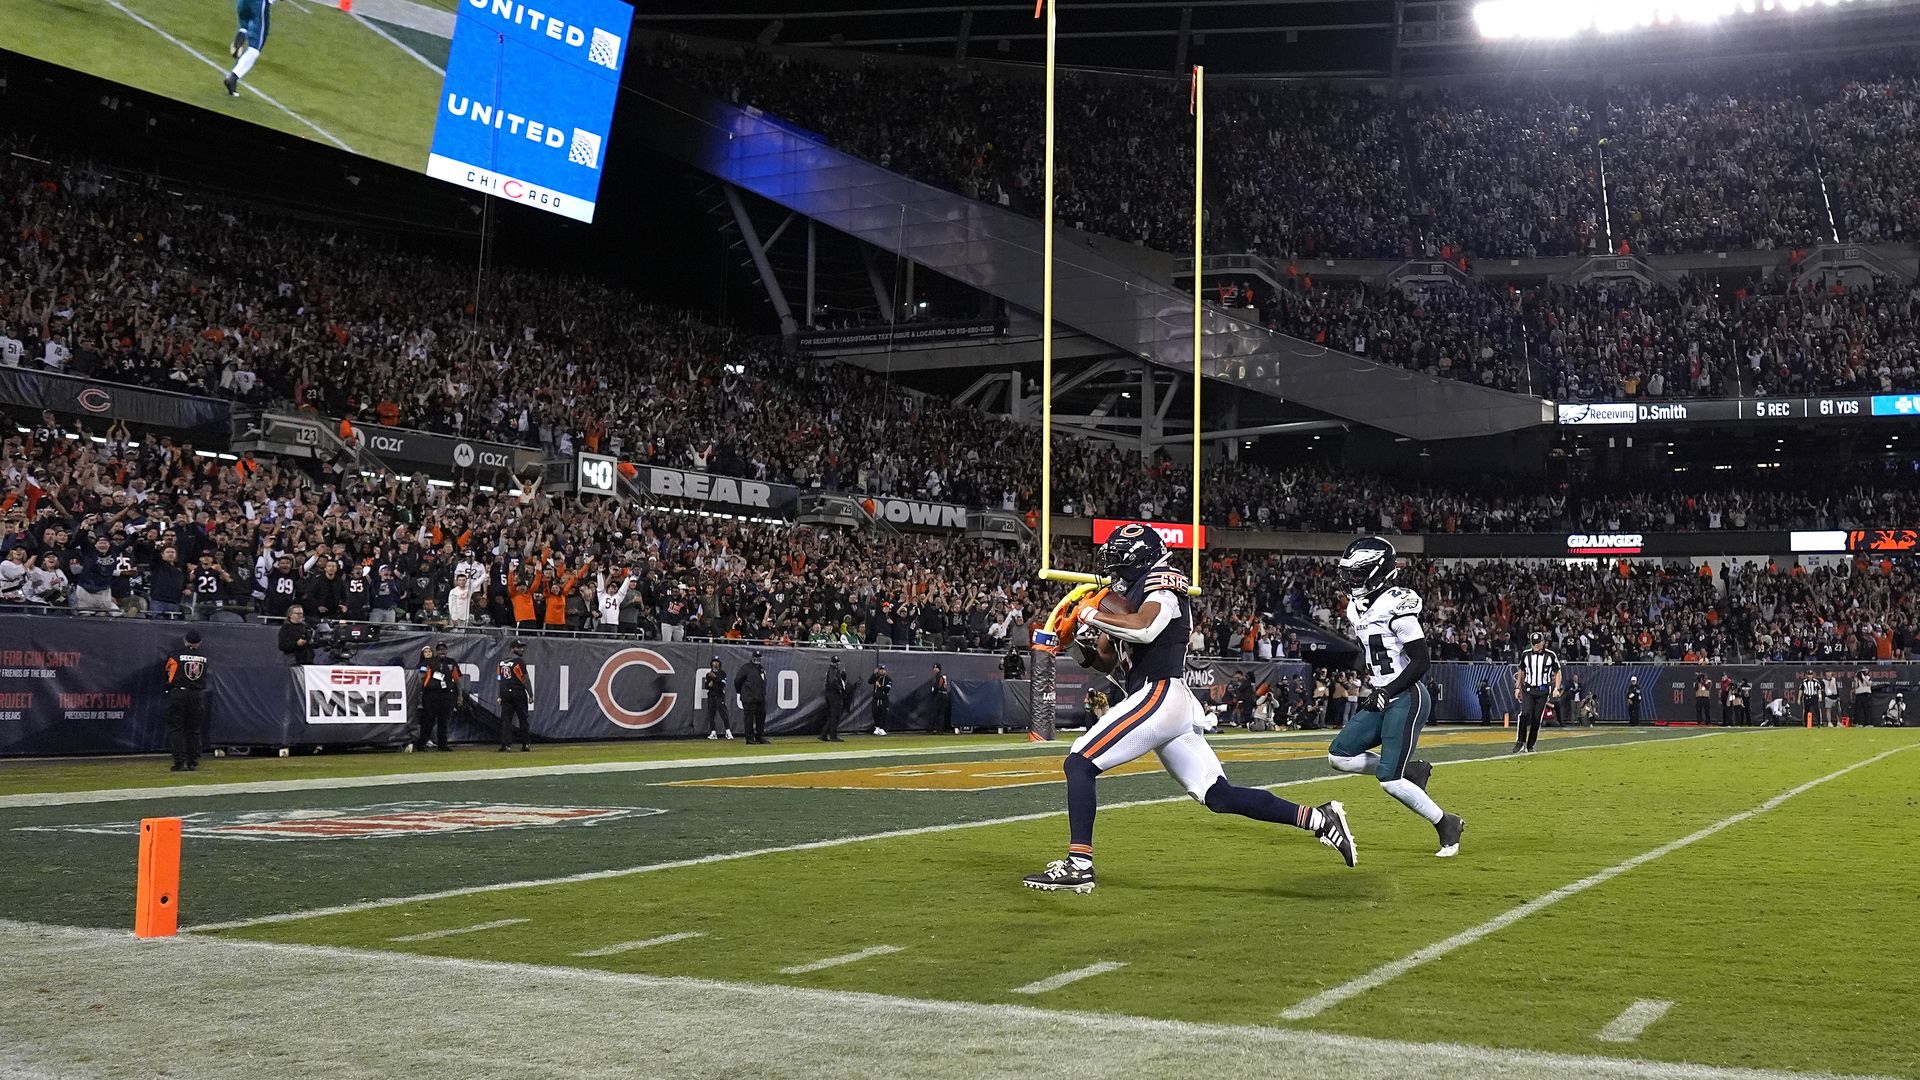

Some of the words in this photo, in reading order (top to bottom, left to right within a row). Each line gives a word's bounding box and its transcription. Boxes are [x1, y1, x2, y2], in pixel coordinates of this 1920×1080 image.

[447, 93, 565, 149] UNITED
[466, 171, 561, 208] CHICAGO
[916, 329, 947, 338] LOCATION
[8, 343, 17, 354] 51
[1590, 408, 1635, 421] Receiving
[1639, 404, 1687, 420] D.Smith
[1756, 402, 1766, 416] 5
[1768, 402, 1790, 416] REC
[1819, 400, 1833, 415] 61
[1837, 401, 1859, 415] YDS
[300, 427, 317, 443] 123
[370, 434, 404, 452] razr
[478, 451, 509, 467] razr
[582, 460, 613, 490] 40
[650, 468, 771, 508] BEAR
[1567, 534, 1643, 548] GRAINGER
[116, 556, 132, 573] 25
[465, 568, 477, 580] 52
[1160, 573, 1183, 590] GSH
[197, 576, 218, 593] 23
[276, 577, 294, 594] 89
[604, 598, 618, 611] 54
[3, 650, 23, 667] FOR
[24, 650, 46, 668] GUN
[46, 650, 81, 668] SAFETY
[31, 669, 40, 677] THE
[40, 669, 57, 678] BEARS
[329, 669, 381, 686] ESPN
[105, 692, 133, 709] TEAM
[309, 689, 402, 718] MNF
[5, 711, 21, 720] BEARS
